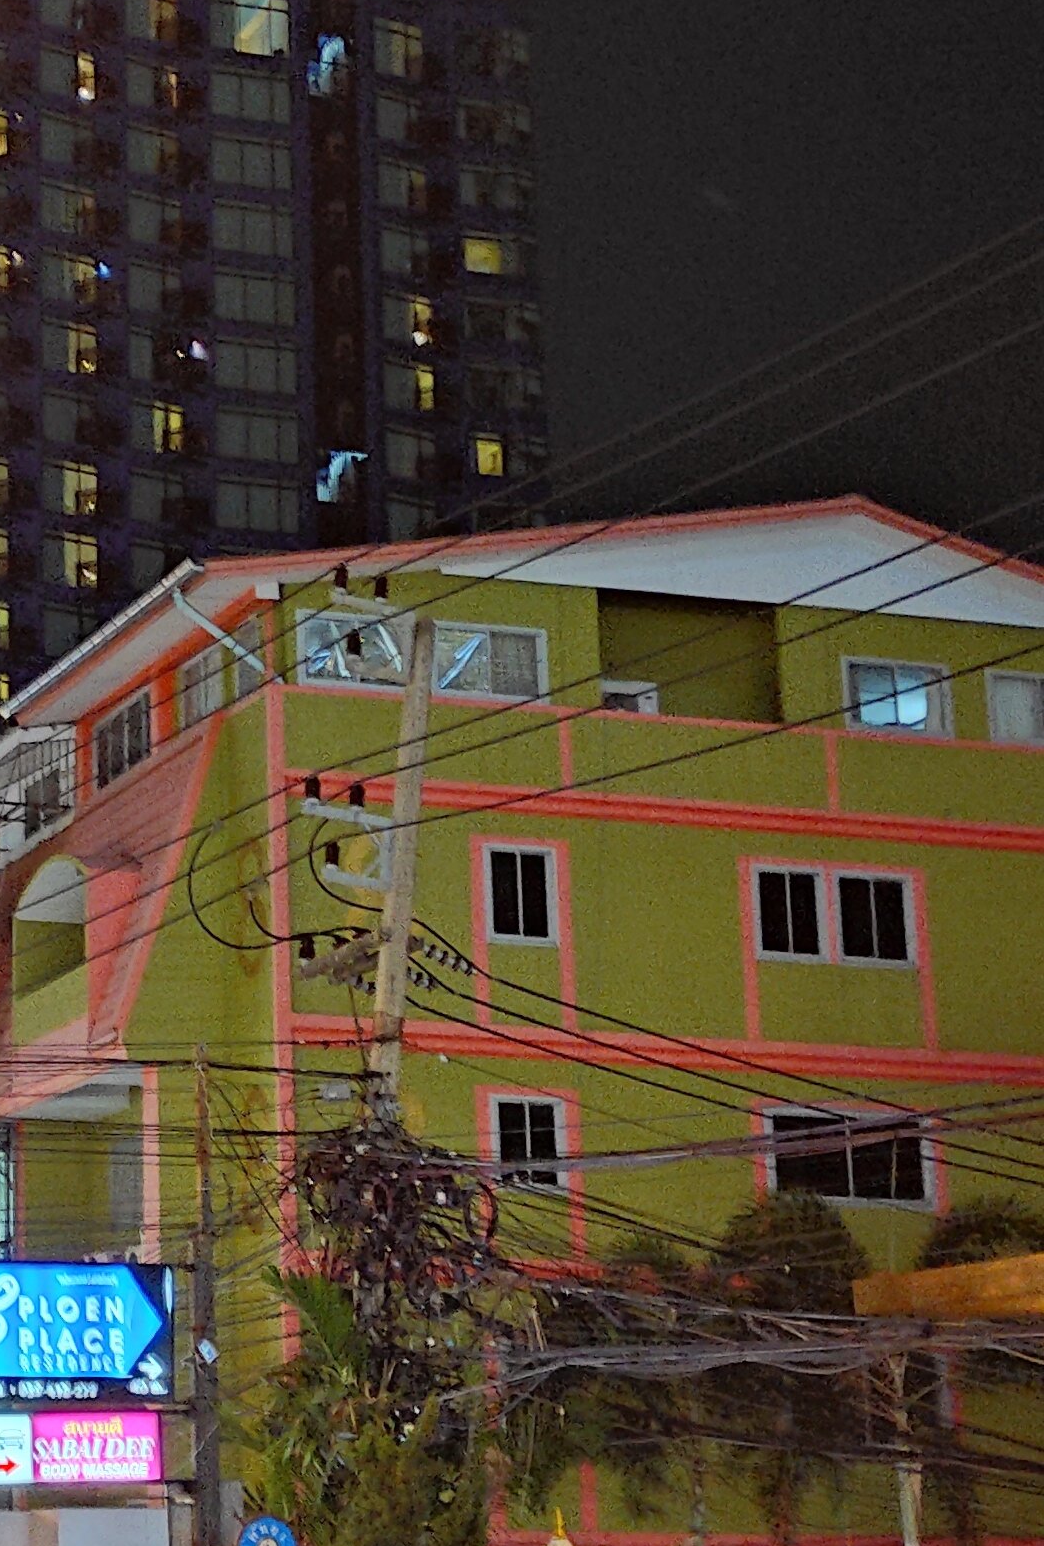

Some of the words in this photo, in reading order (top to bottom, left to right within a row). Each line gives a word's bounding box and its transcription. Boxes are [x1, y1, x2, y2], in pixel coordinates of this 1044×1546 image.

[18, 1295, 125, 1324] PLOEN
[18, 1327, 125, 1354] PLACE
[34, 1437, 103, 1460] SABAI
[105, 1437, 155, 1460] DEE
[40, 1463, 80, 1479] BODY
[83, 1462, 149, 1479] MASSAGE
